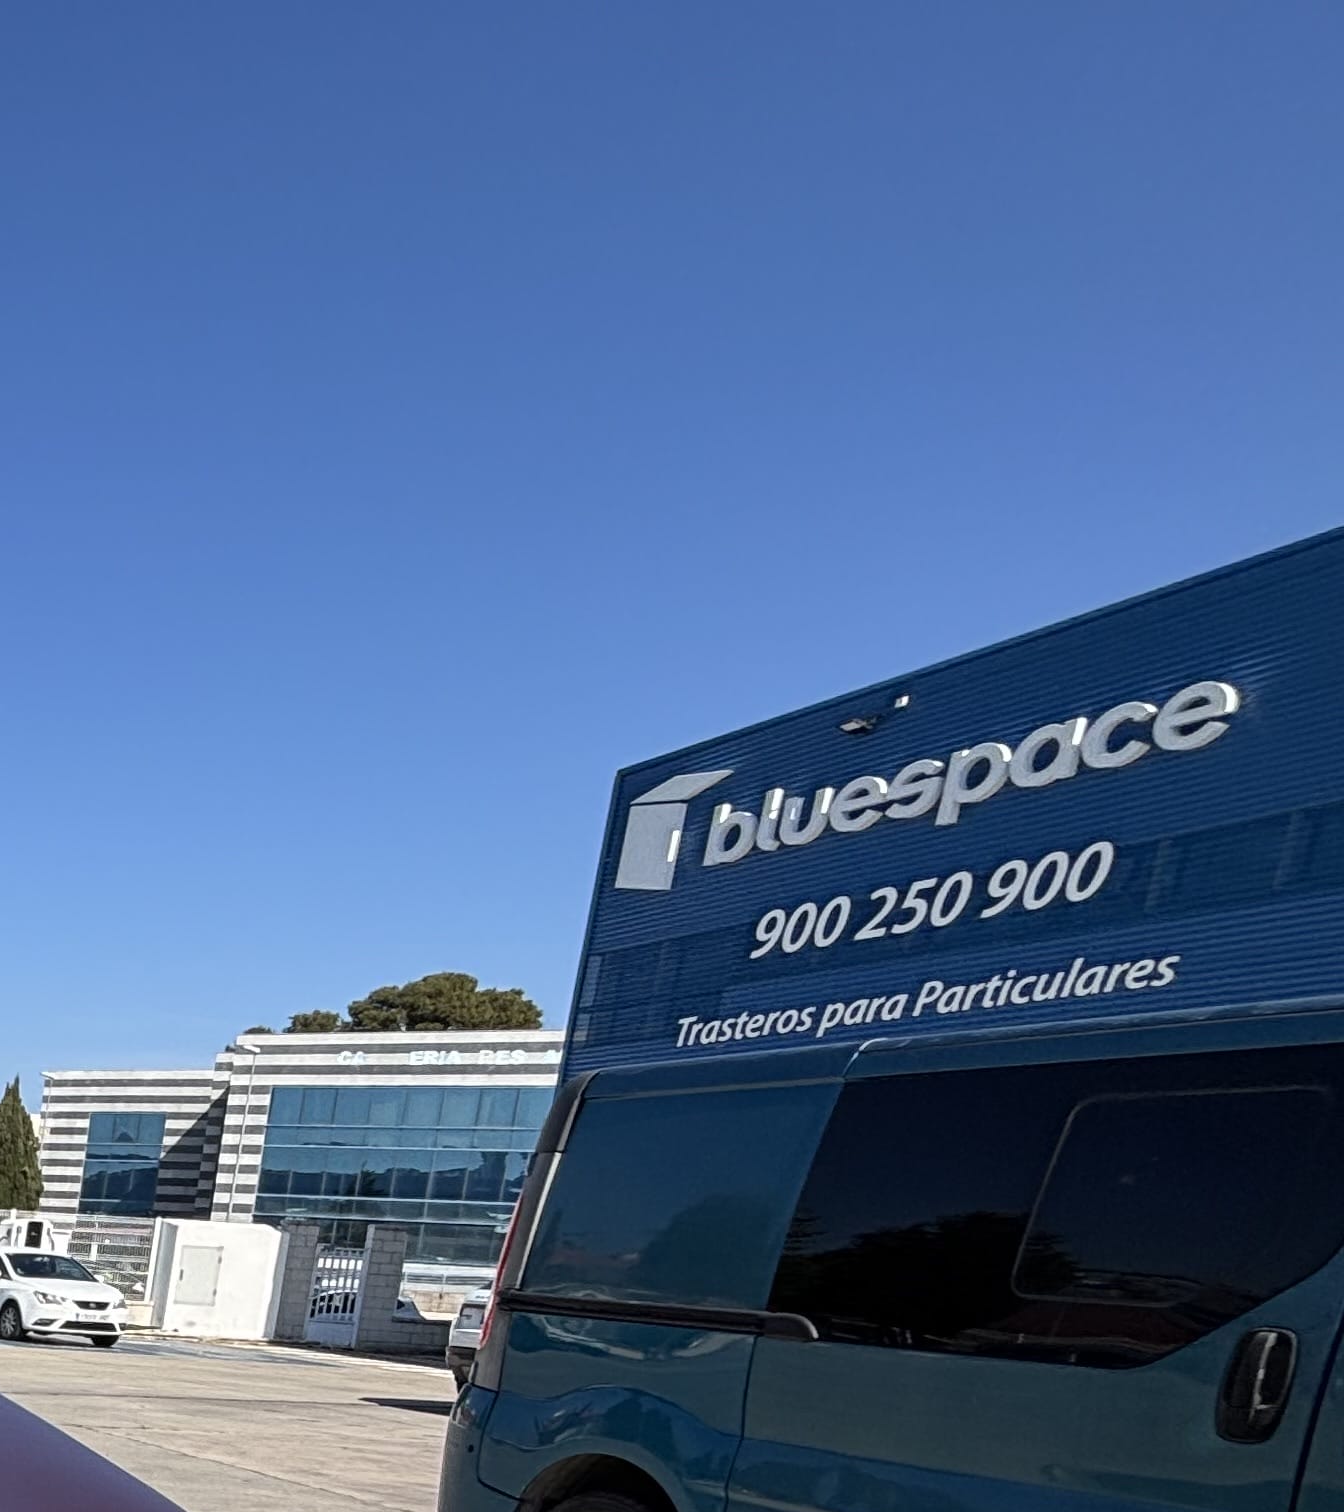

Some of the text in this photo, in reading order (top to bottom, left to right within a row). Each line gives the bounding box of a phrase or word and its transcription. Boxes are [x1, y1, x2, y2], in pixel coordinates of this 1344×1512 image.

[701, 680, 1240, 867] bluespace
[749, 840, 1114, 960] 900 250 900
[675, 954, 1182, 1048] Trasteros para Particulares
